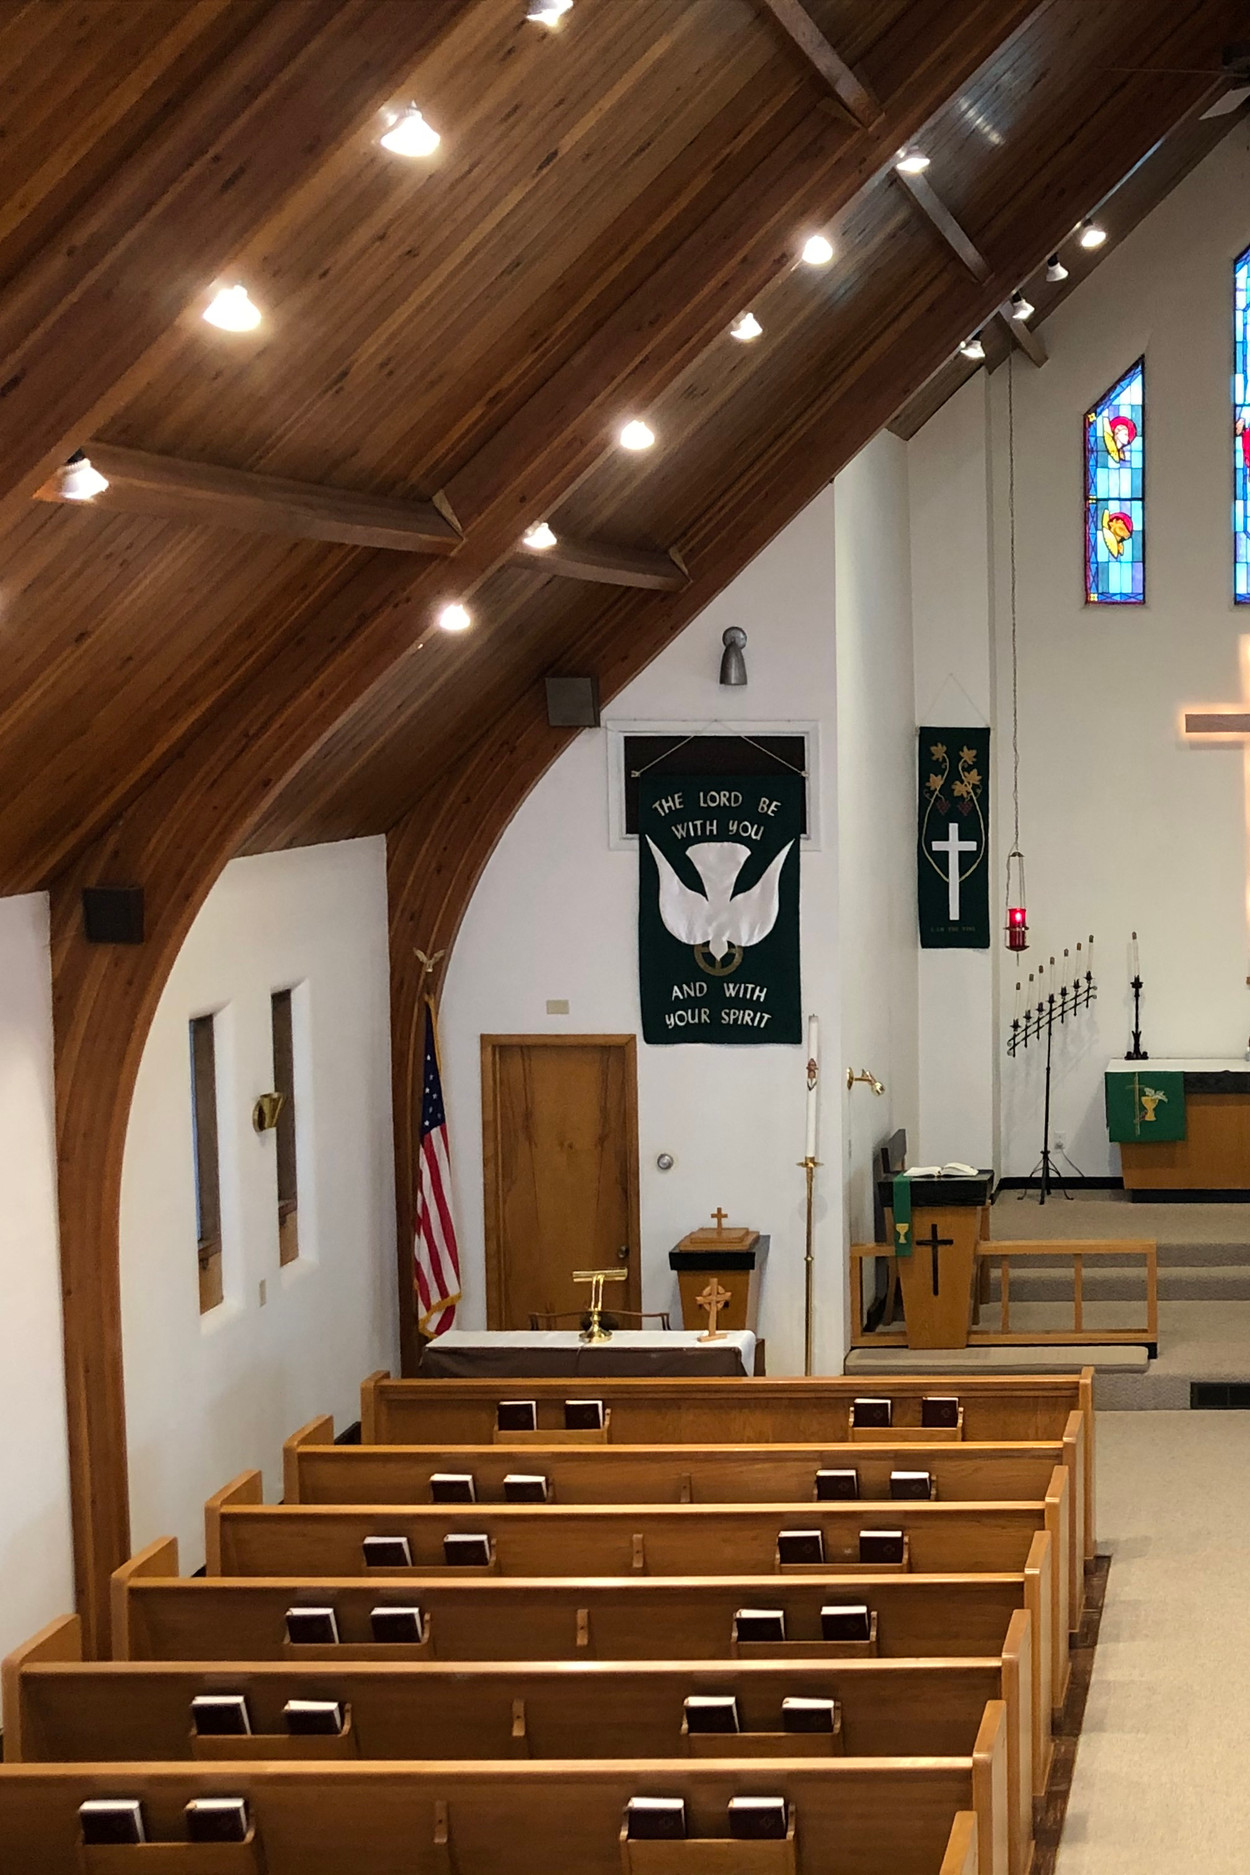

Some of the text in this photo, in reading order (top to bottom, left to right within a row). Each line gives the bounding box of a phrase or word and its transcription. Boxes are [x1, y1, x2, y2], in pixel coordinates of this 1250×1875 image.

[652, 791, 781, 817] THE LORD BE
[671, 820, 764, 840] WITH YOU
[671, 982, 768, 1003] AND WITH
[665, 1009, 772, 1030] YOUR SPIRIT
